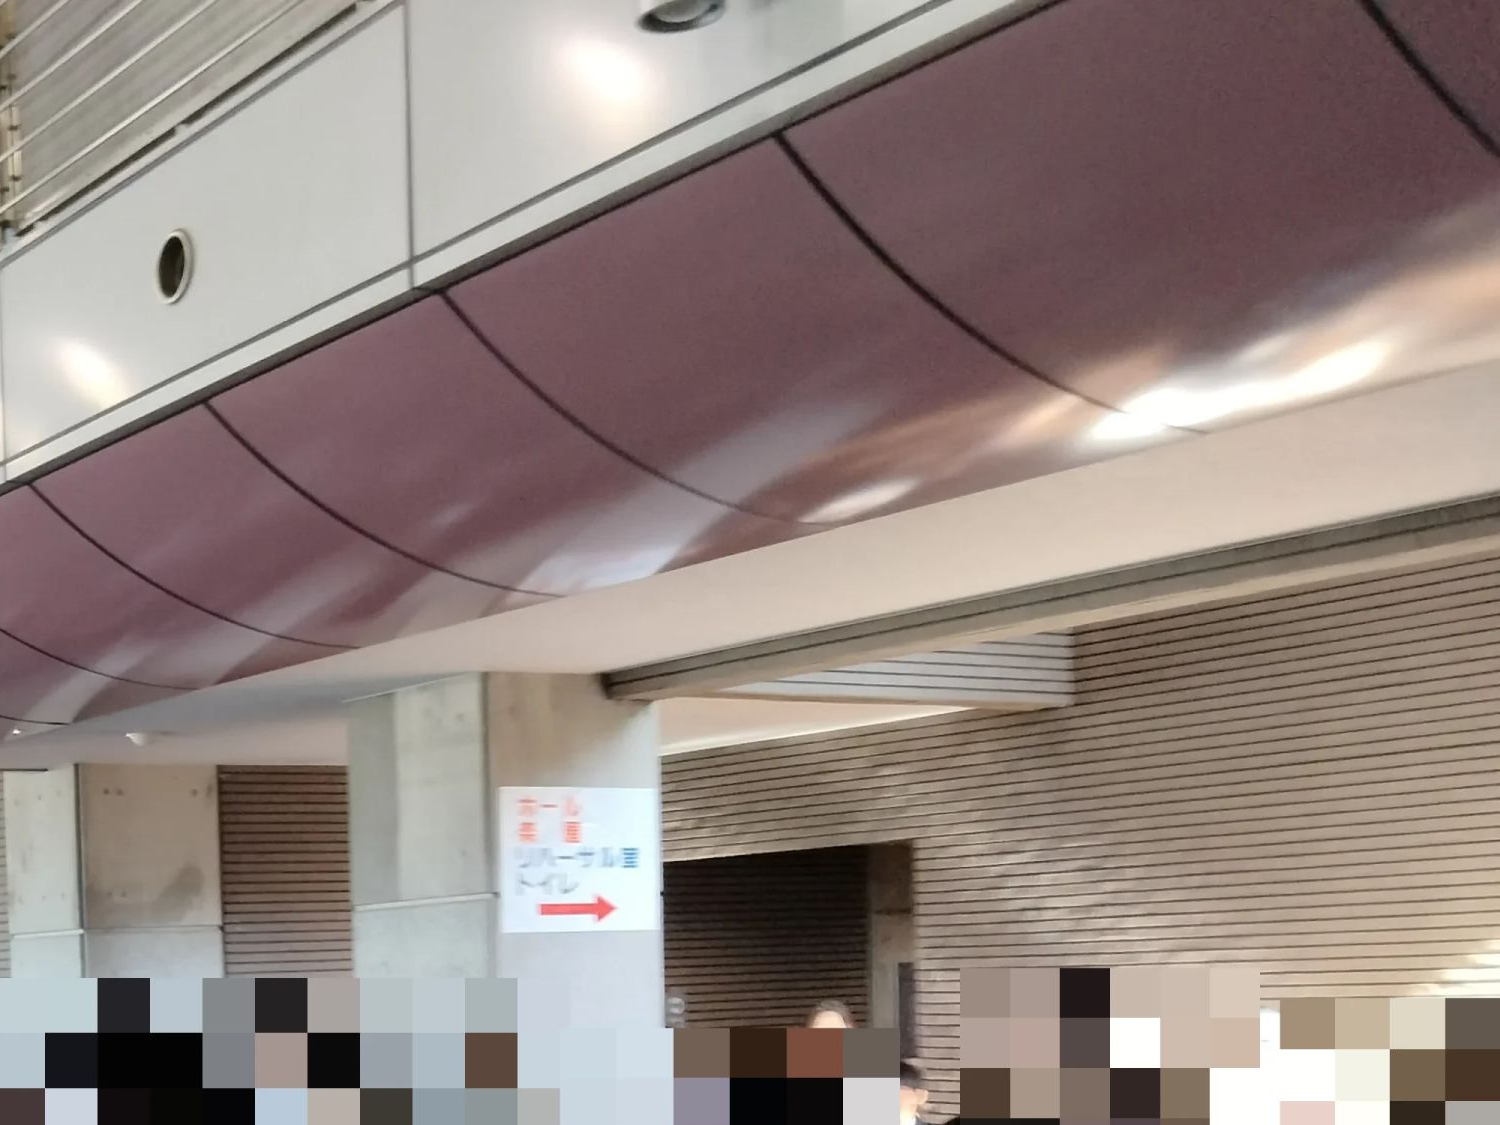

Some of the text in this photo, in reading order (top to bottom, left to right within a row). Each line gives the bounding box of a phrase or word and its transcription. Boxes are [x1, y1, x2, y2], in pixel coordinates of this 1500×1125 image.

[514, 847, 639, 869] リハーサル室
[515, 873, 579, 897] トイレ
